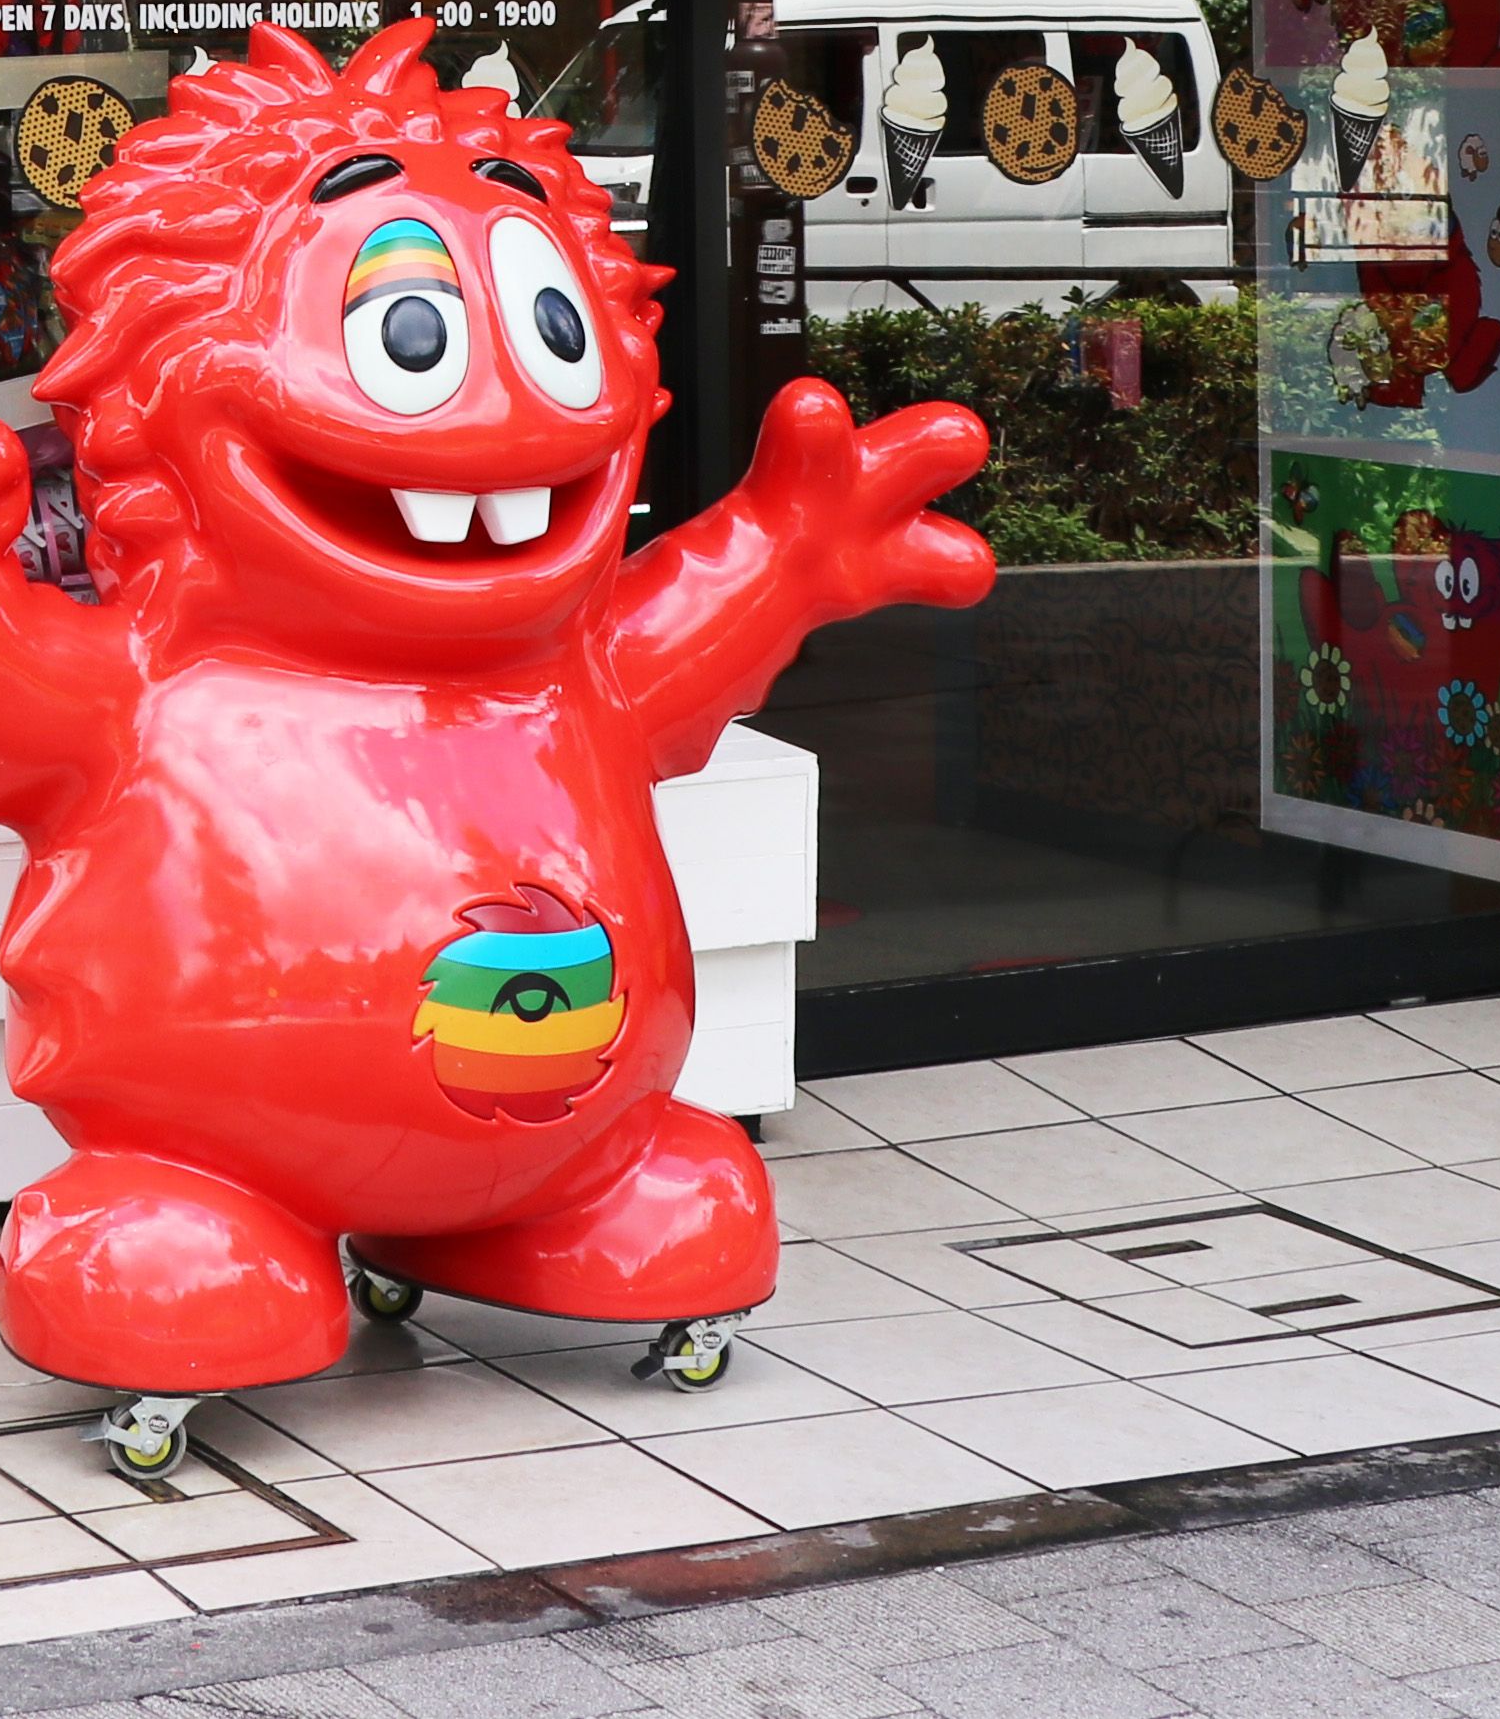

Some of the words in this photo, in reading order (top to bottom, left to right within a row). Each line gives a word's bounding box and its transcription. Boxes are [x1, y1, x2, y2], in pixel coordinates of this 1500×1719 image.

[41, 3, 55, 32] 7
[63, 2, 131, 33] DAYS,
[139, 2, 263, 31] INCLUDING
[270, 1, 380, 30] HOLIDAYS
[409, 0, 473, 28] 1:00
[494, 0, 557, 28] 19:00
